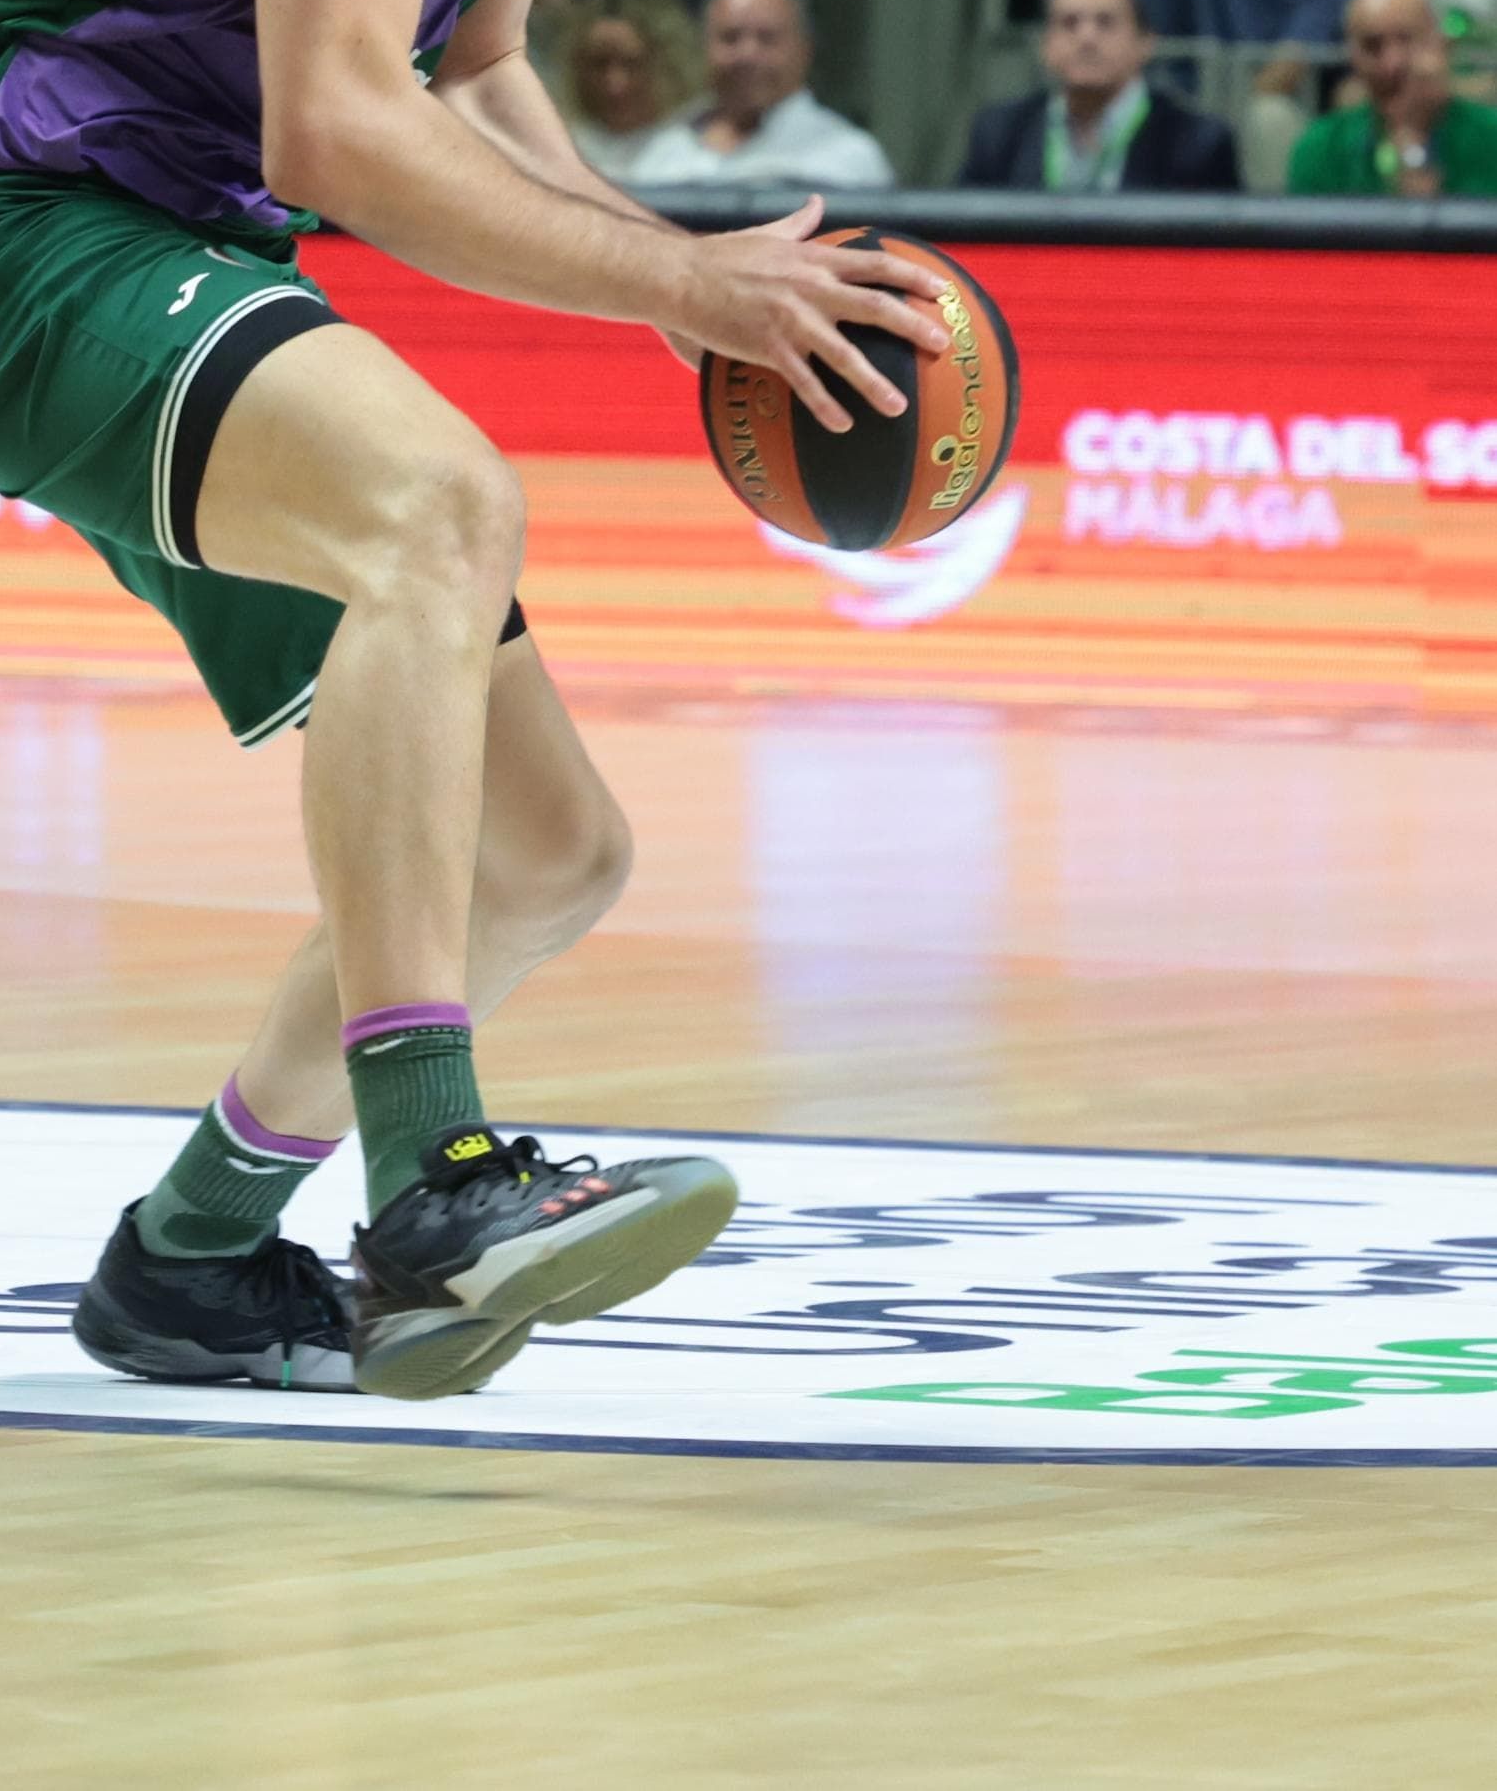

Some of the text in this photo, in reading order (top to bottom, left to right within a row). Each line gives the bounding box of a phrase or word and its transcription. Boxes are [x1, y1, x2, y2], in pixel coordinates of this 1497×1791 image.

[1064, 409, 1282, 476] COSTA
[1288, 413, 1418, 482] DEL
[808, 1337, 1497, 1420] Bal
